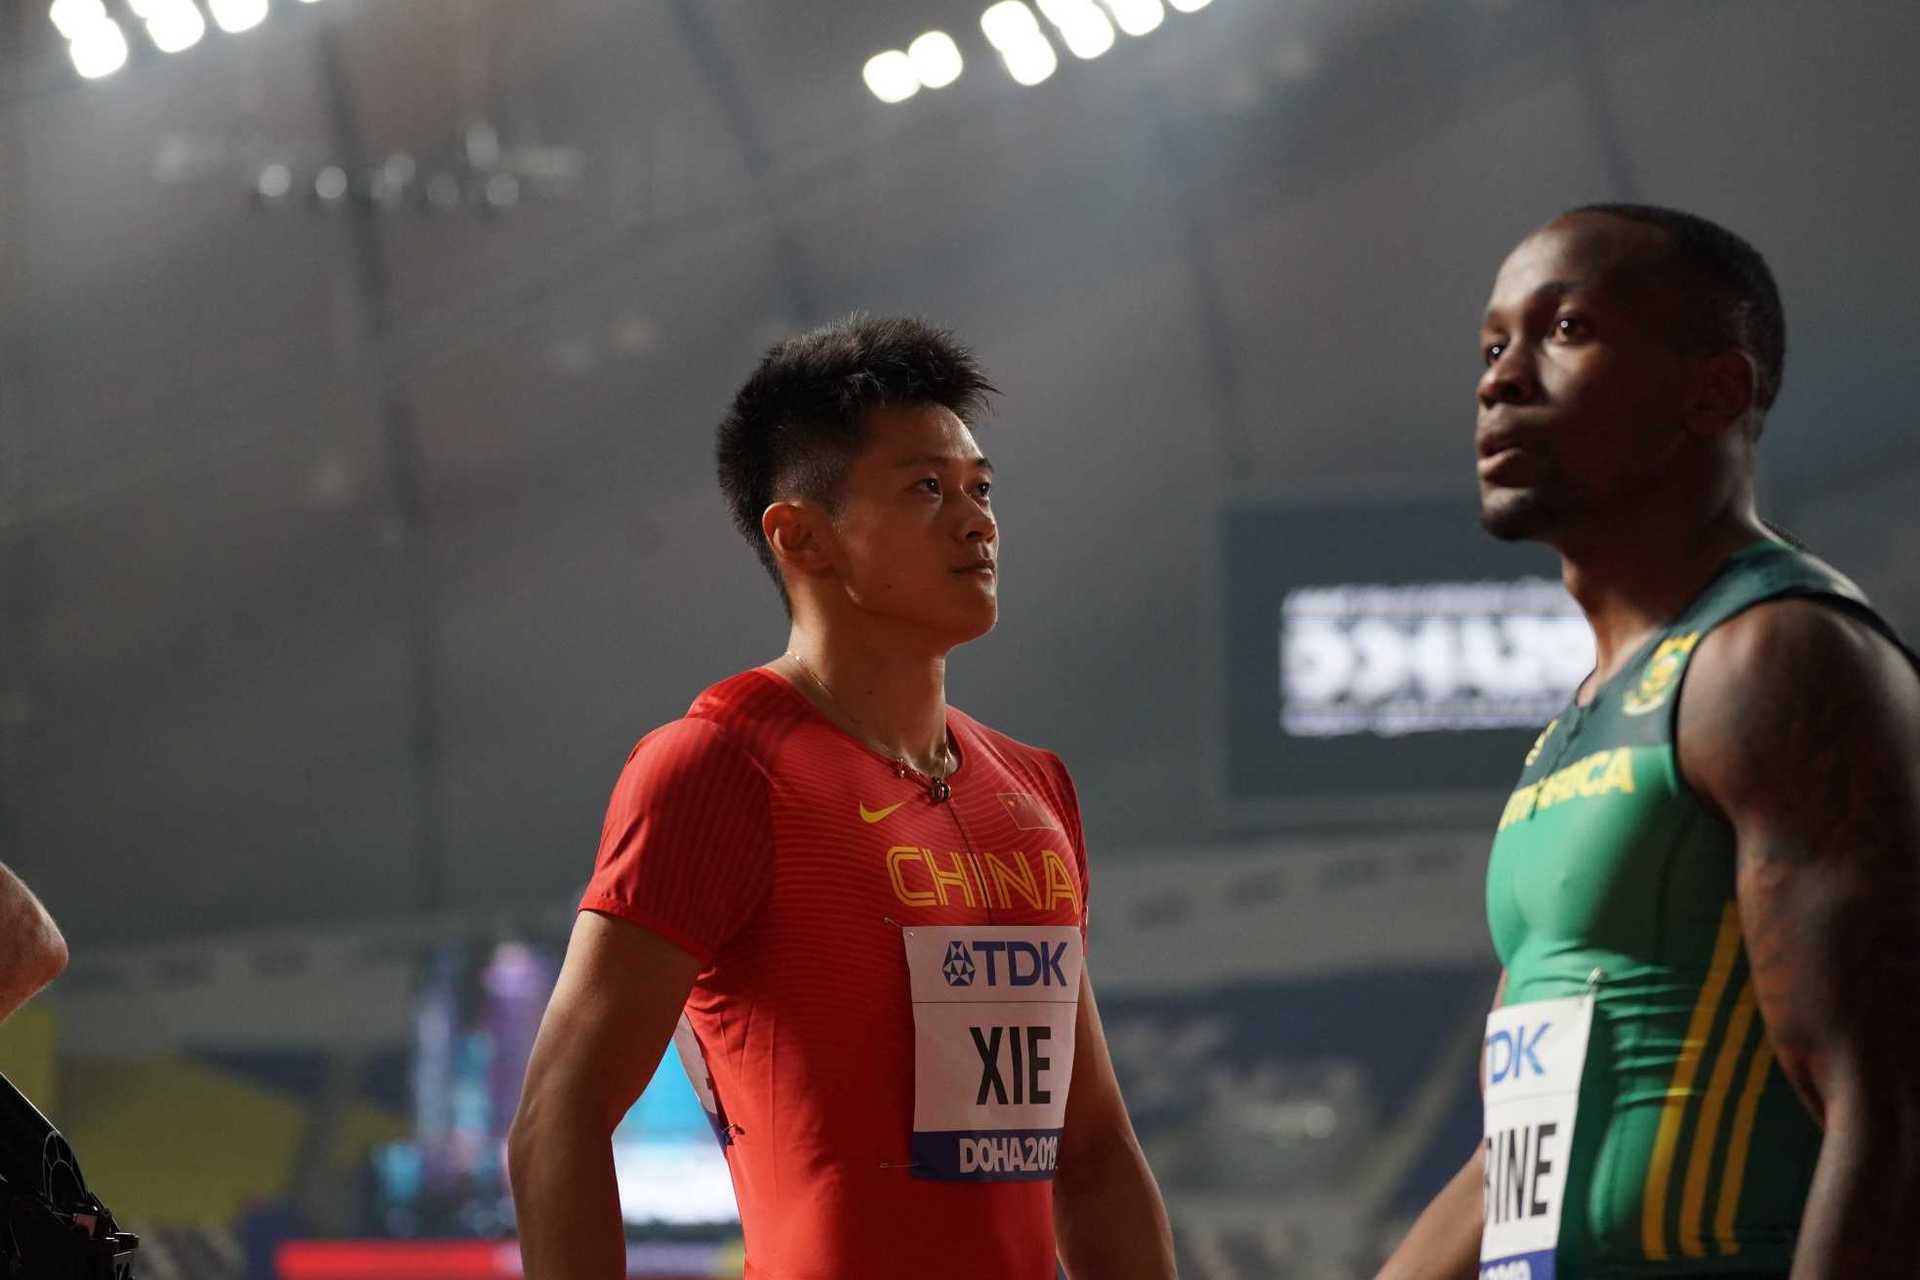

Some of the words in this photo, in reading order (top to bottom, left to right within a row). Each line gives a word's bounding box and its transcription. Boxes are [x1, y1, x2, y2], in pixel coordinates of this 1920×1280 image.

[886, 846, 1081, 915] CHINA
[972, 941, 1069, 988] TDK
[969, 1026, 1052, 1106] XIE
[1486, 1023, 1552, 1084] DK
[1485, 1123, 1557, 1225] INE
